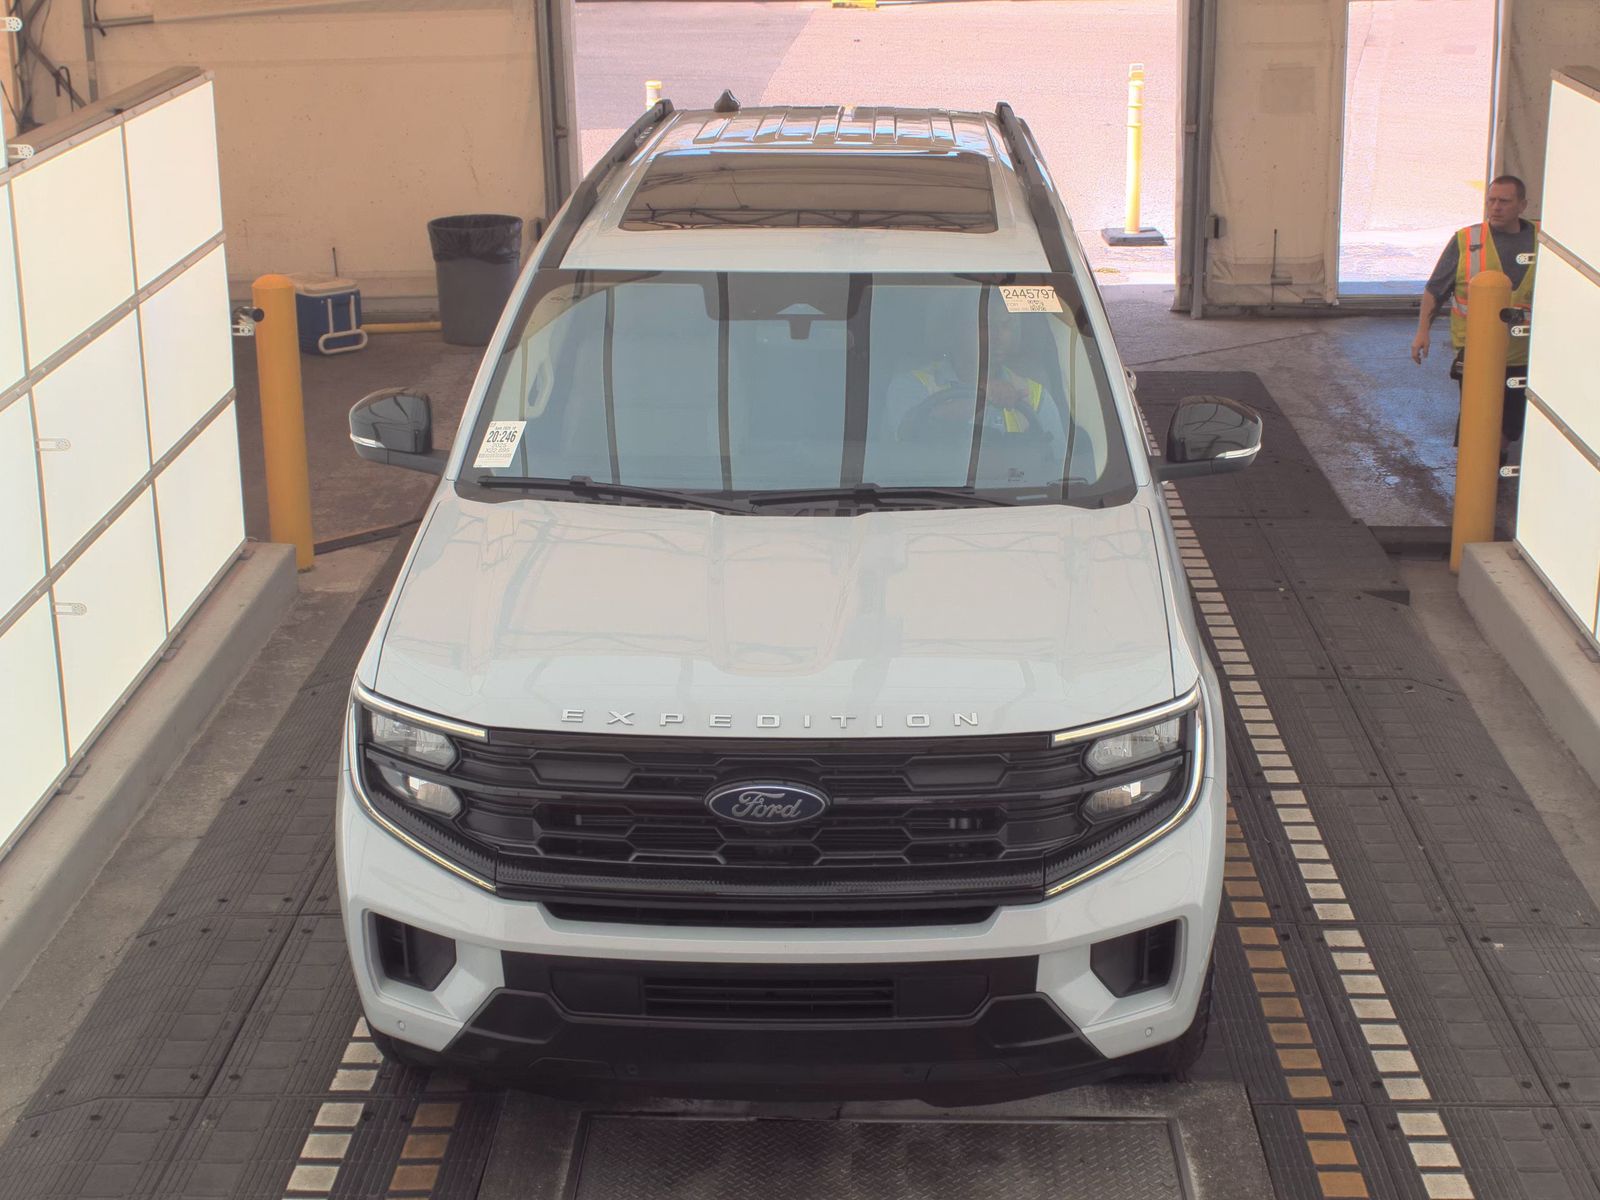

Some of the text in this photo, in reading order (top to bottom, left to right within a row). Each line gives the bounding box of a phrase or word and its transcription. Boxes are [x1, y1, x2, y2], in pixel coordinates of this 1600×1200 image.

[1003, 288, 1056, 299] 2445797
[486, 430, 518, 443] 20:246
[560, 708, 980, 729] EXPEDITION
[731, 790, 803, 818] Ford
